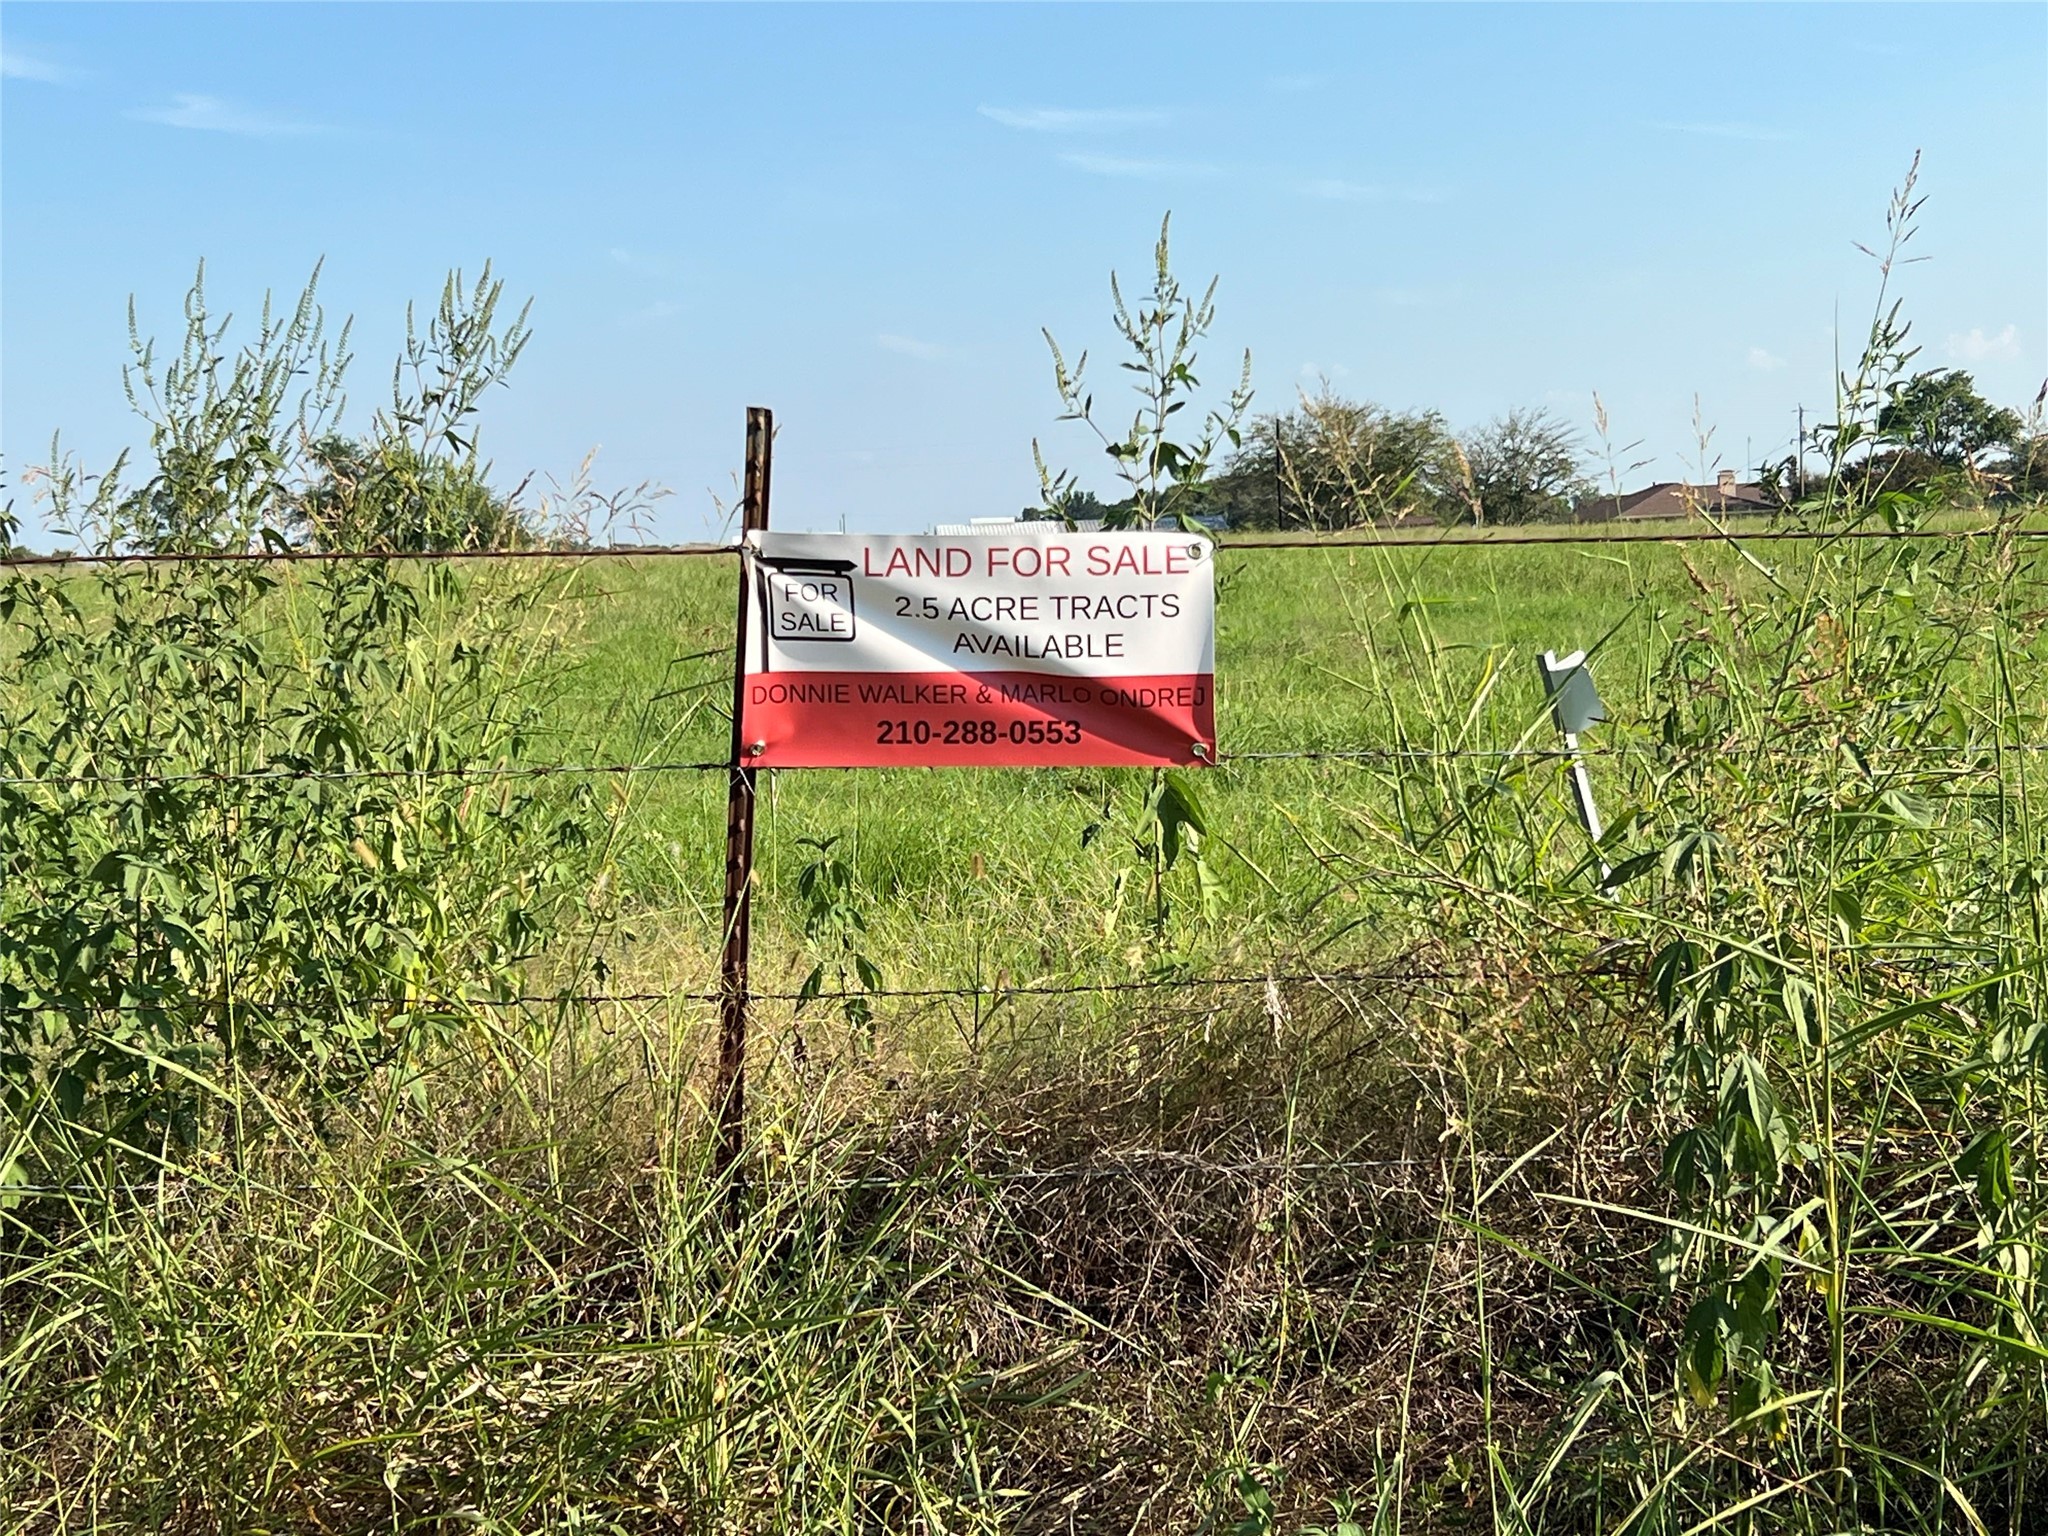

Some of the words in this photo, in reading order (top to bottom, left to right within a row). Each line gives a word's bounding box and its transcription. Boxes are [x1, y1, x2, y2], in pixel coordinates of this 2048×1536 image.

[864, 546, 971, 578] LAND
[986, 546, 1073, 577] FOR
[1086, 545, 1191, 576] SALE
[785, 583, 839, 602] FOR
[895, 596, 939, 619] 2.5
[947, 596, 1039, 621] ACRE
[1048, 594, 1180, 619] TRACTS
[780, 612, 847, 633] SALE
[953, 633, 1125, 659] AVAILABLE
[752, 684, 851, 705] DONNIE
[858, 684, 967, 704] WALKER
[976, 685, 993, 704] &
[1001, 683, 1091, 704] MARLO
[1099, 687, 1206, 707] ONDREJ
[876, 719, 1082, 745] 210-288-0553
